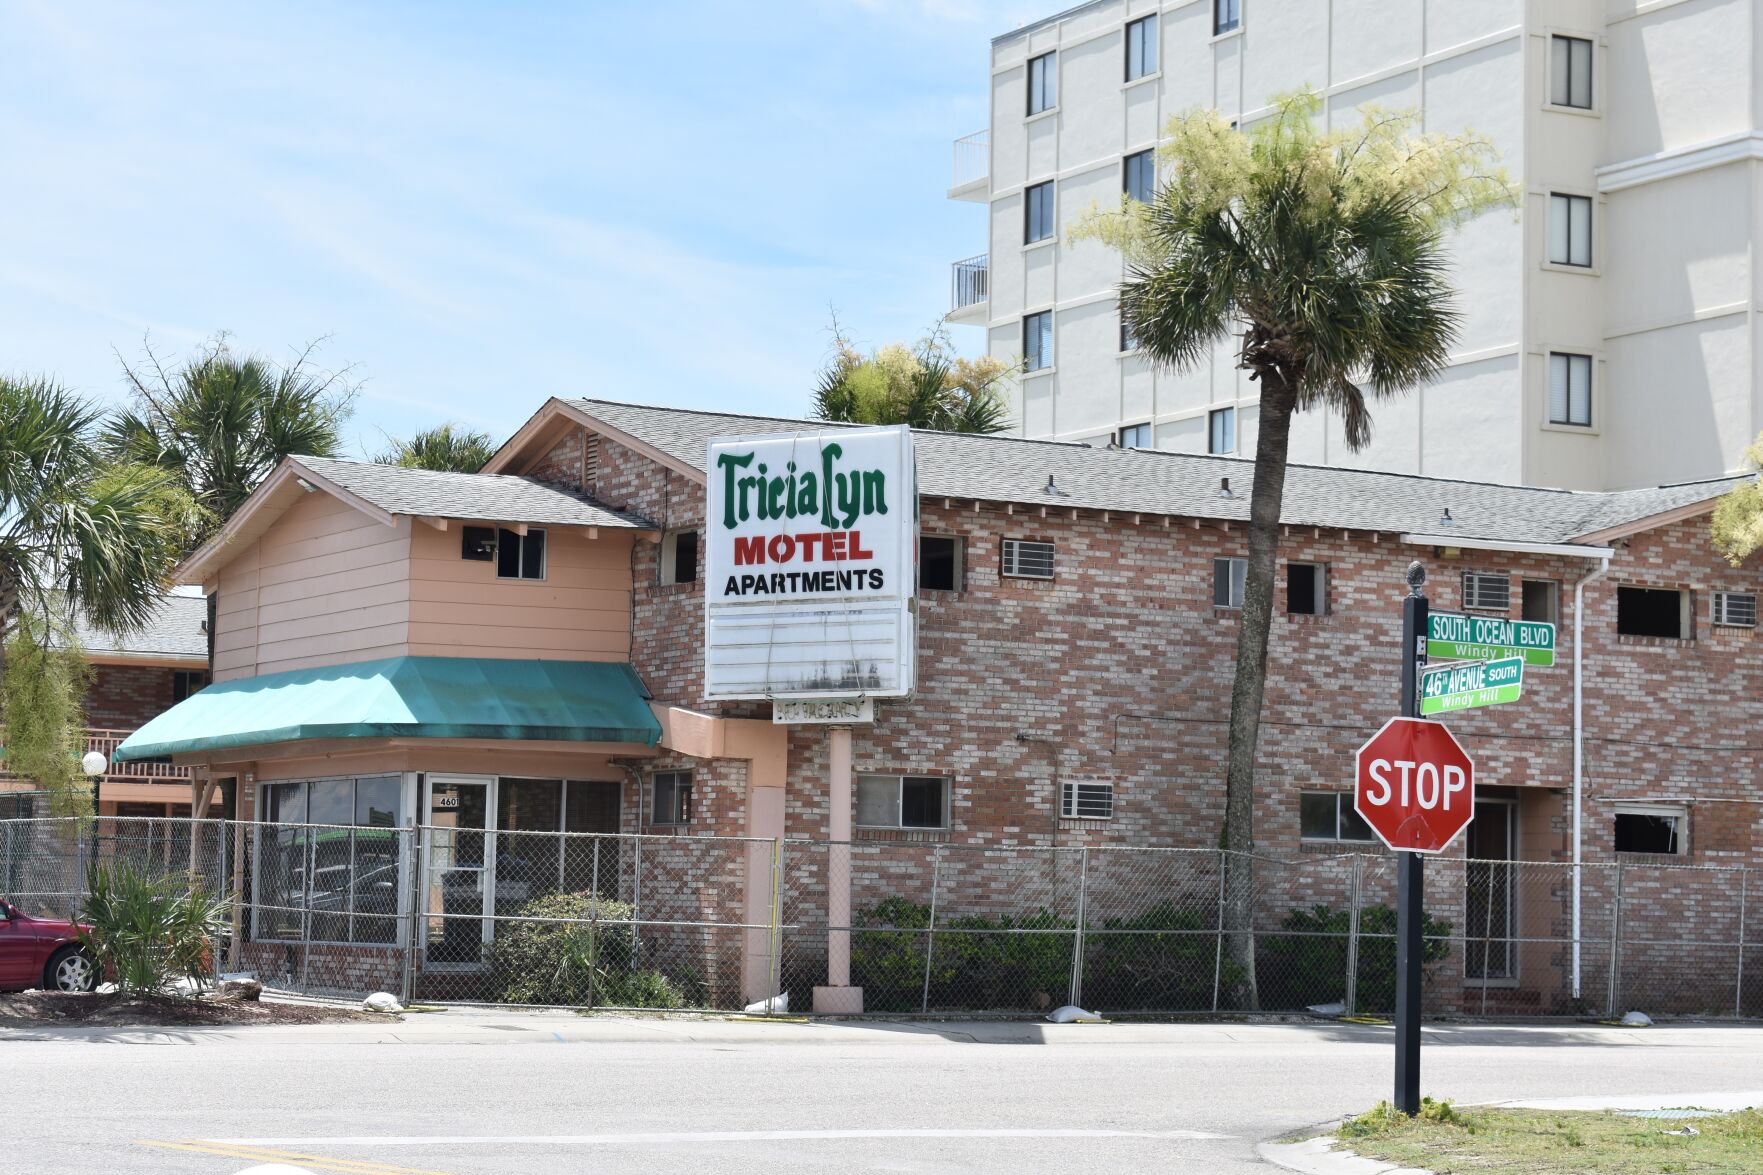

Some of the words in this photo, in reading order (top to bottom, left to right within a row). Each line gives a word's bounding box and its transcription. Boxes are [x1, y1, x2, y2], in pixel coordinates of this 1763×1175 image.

[734, 531, 873, 566] MOTEL
[724, 568, 884, 595] APARTMENTS
[1433, 616, 1471, 641] SOUTH
[1476, 620, 1514, 645] OCEAN
[1520, 626, 1549, 646] BLVD
[1455, 644, 1497, 660] Windy
[1504, 647, 1527, 661] Hill
[1448, 667, 1486, 694] AVENUE
[1488, 665, 1517, 681] SOUTH
[1442, 692, 1473, 708] Windy
[1479, 689, 1498, 703] Hill
[1366, 758, 1466, 811] STOP
[440, 798, 459, 806] 4601
